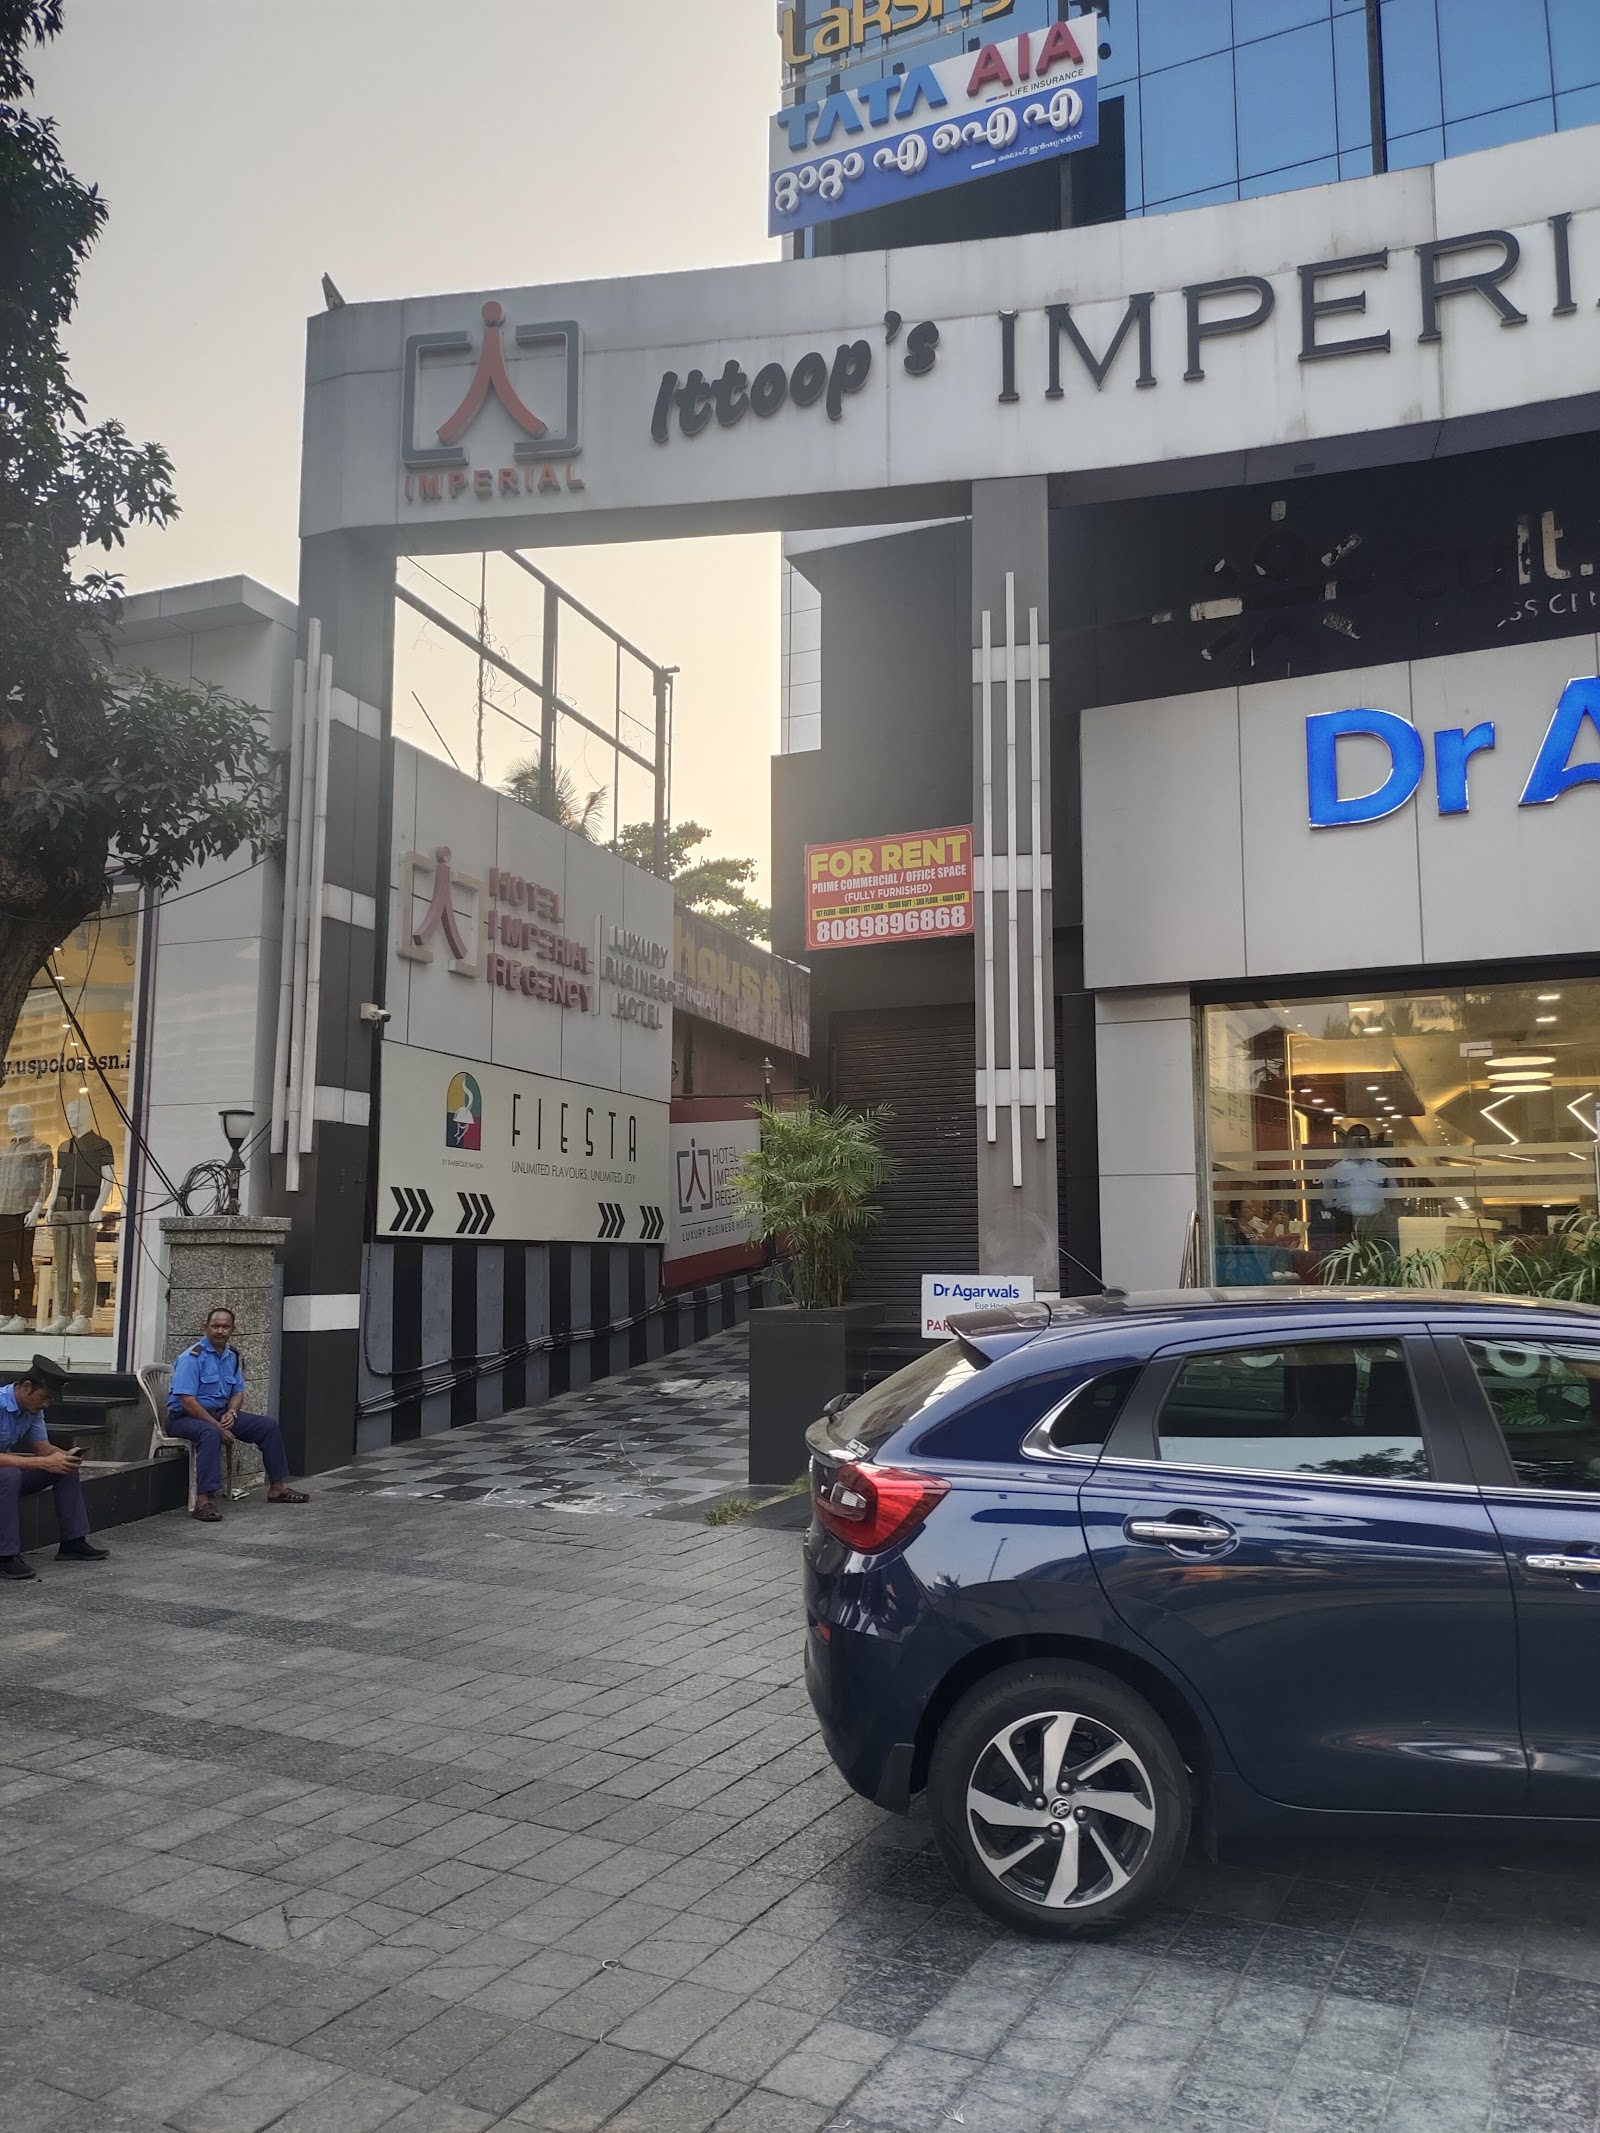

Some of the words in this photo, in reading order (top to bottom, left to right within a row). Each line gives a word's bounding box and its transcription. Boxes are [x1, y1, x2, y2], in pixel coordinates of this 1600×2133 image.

[966, 21, 1084, 98] AIA
[1009, 85, 1029, 98] LIFE
[1030, 68, 1084, 91] INSURANCE
[777, 64, 948, 151] TATA
[998, 211, 1600, 402] IMPERI
[404, 463, 585, 502] IMPERIAL
[1305, 708, 1496, 831] Dr
[810, 848, 873, 881] FOR
[881, 834, 967, 872] RENT
[812, 880, 839, 894] PRIME
[840, 873, 898, 891] COMMERCIAL
[906, 868, 936, 882] OFFICE
[937, 864, 967, 879] SPACE
[489, 867, 564, 923] HOTEL
[844, 889, 876, 903] (FULLY
[877, 883, 933, 899] FURNISHED)
[488, 909, 592, 975] IMPERIAL
[816, 905, 966, 943] 8089896868
[609, 925, 668, 969] LUXURY
[487, 952, 593, 1012] REGENCY
[600, 956, 676, 1003] BUSINESS
[611, 993, 663, 1030] HOTEL
[512, 1093, 636, 1162] FIESTA
[511, 1161, 550, 1176] UNLIMITED
[551, 1164, 589, 1180] FLAVOURS,
[590, 1168, 622, 1184] UNLIMITED
[623, 1172, 636, 1185] JOY
[711, 1147, 739, 1165] HOTEL
[682, 1227, 706, 1242] LUXURY
[707, 1221, 736, 1237] BUSINESS
[933, 1283, 950, 1297] Dr
[952, 1283, 1020, 1301] Agarwals
